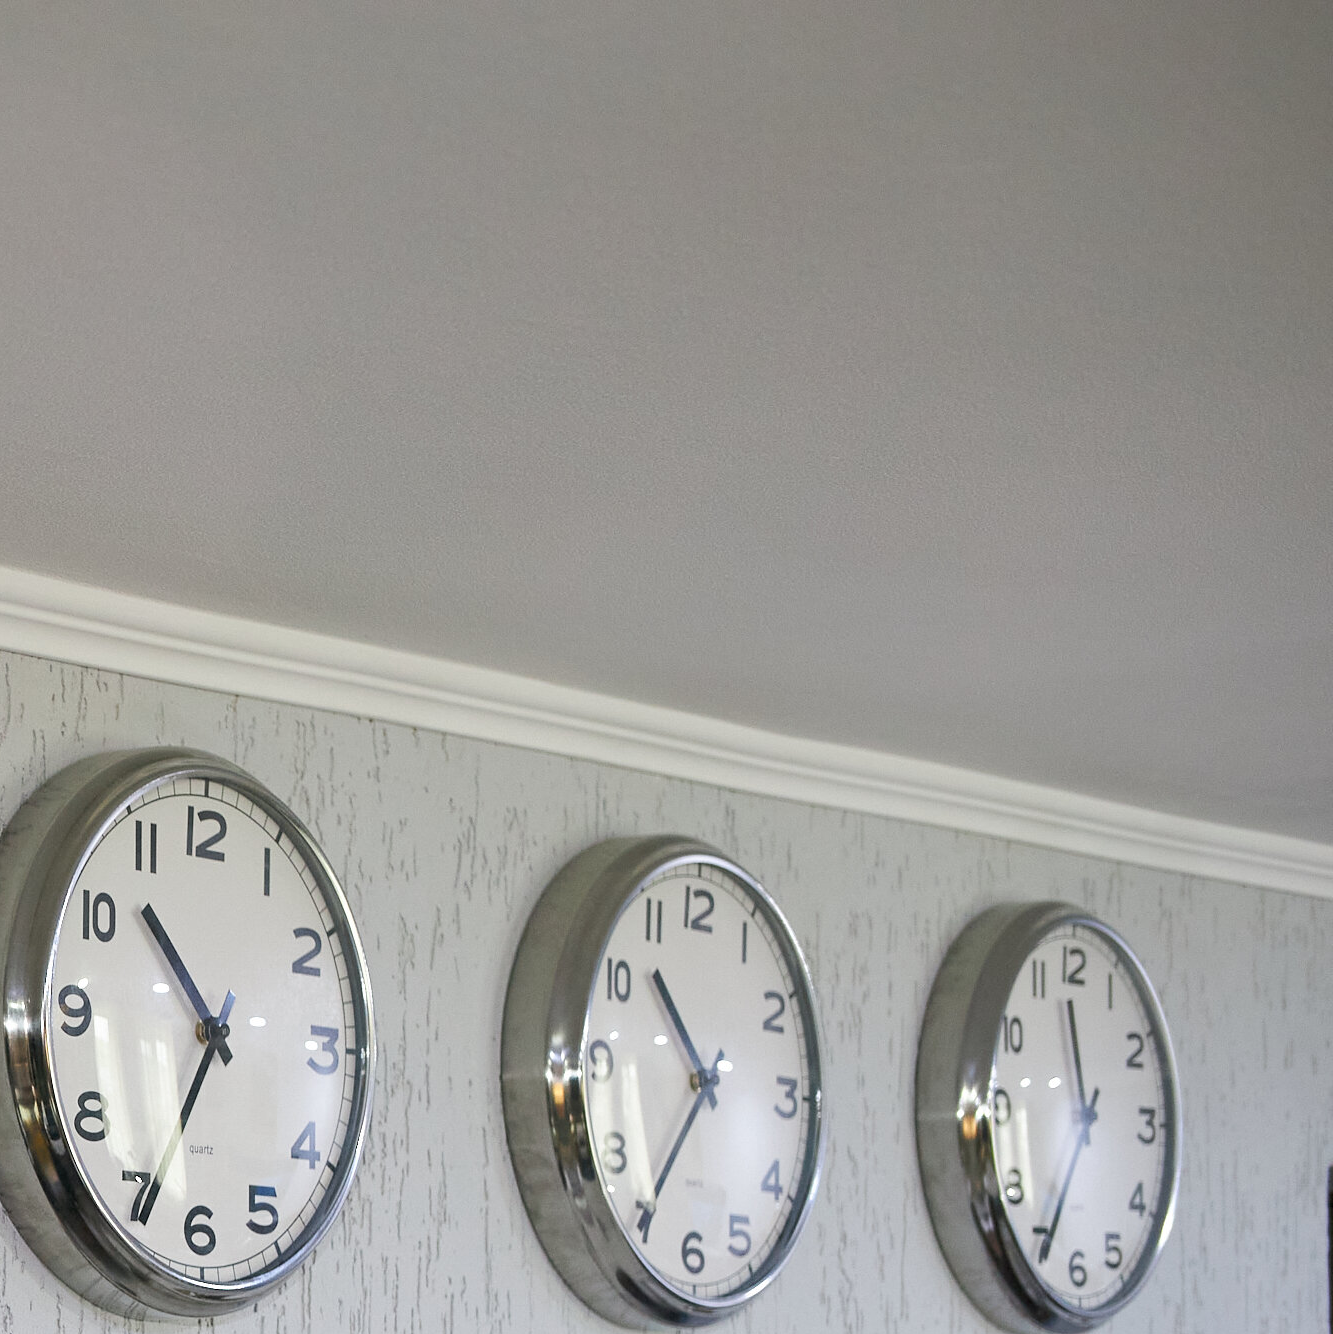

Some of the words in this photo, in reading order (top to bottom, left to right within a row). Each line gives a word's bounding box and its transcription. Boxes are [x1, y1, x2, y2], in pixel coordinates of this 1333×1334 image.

[135, 820, 157, 873] 11
[187, 806, 227, 861] 12
[264, 848, 270, 896] 1
[83, 890, 116, 942] 10
[684, 886, 715, 933] 12
[292, 928, 322, 977] 2
[1062, 946, 1086, 986] 12
[58, 984, 92, 1036] 9
[762, 992, 785, 1033] 2
[306, 1026, 339, 1075] 3
[1126, 1033, 1144, 1069] 2
[74, 1092, 110, 1141] 8
[774, 1077, 798, 1119] 3
[189, 1143, 213, 1156] quartz
[291, 1122, 320, 1169] 4
[1137, 1108, 1156, 1144] 3
[122, 1171, 150, 1221] 7
[246, 1186, 277, 1234] 5
[184, 1206, 216, 1256] 6
[682, 1231, 705, 1274] 6
[1069, 1250, 1087, 1287] 6
